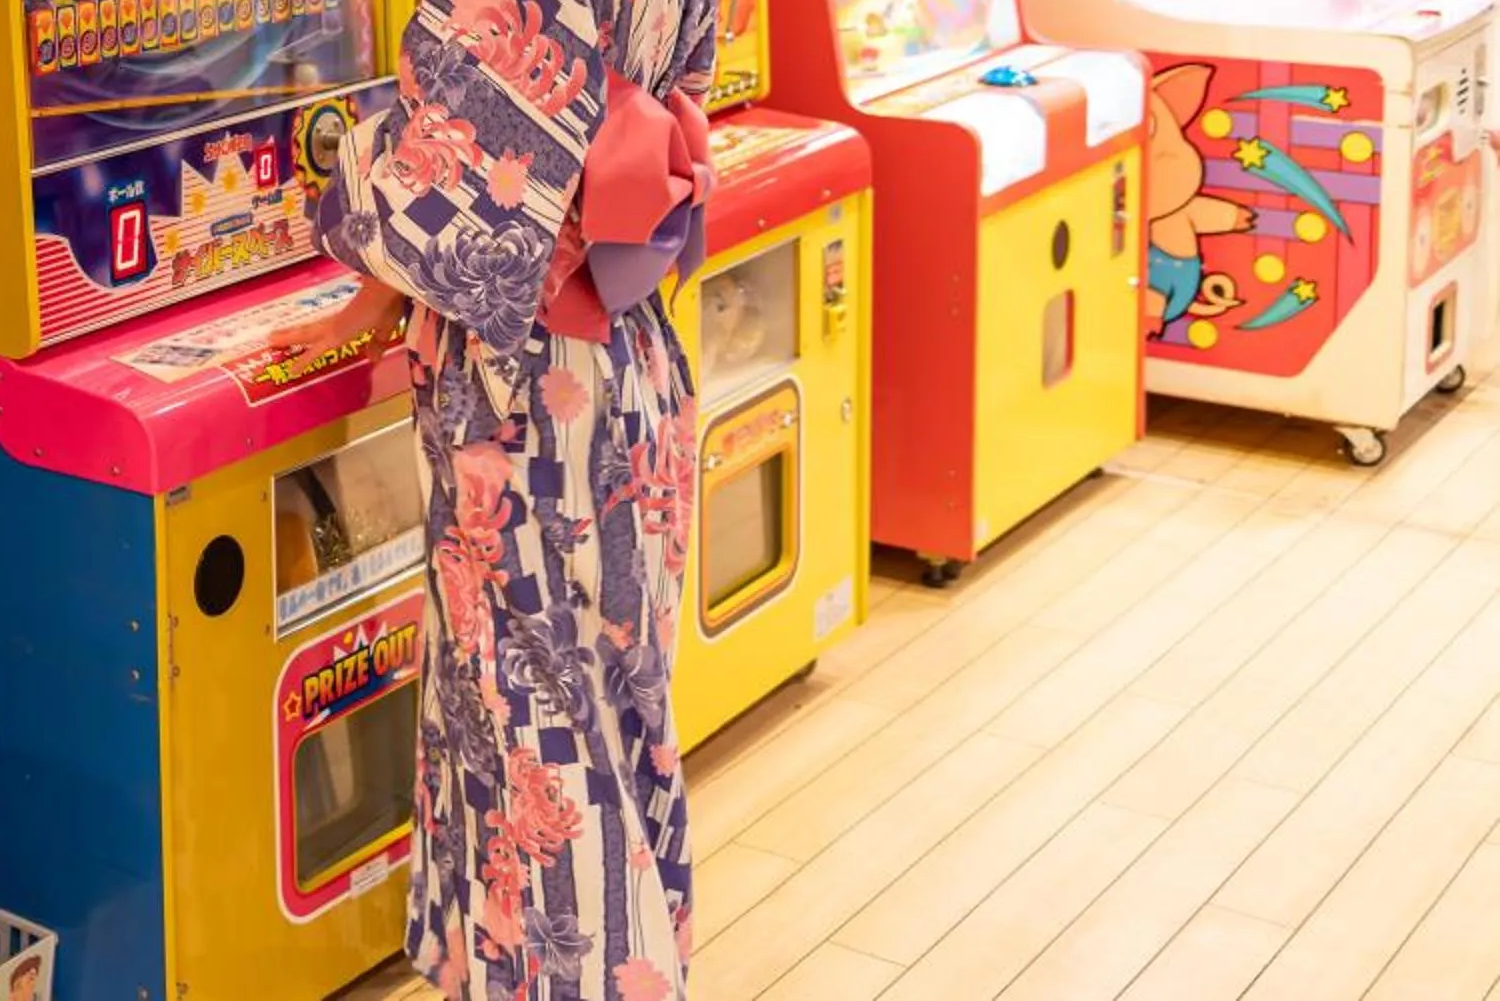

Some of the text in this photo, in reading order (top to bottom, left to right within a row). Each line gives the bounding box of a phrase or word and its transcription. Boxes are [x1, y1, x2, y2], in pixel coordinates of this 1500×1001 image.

[117, 208, 141, 271] 0
[303, 624, 417, 717] PRIZE OUT
